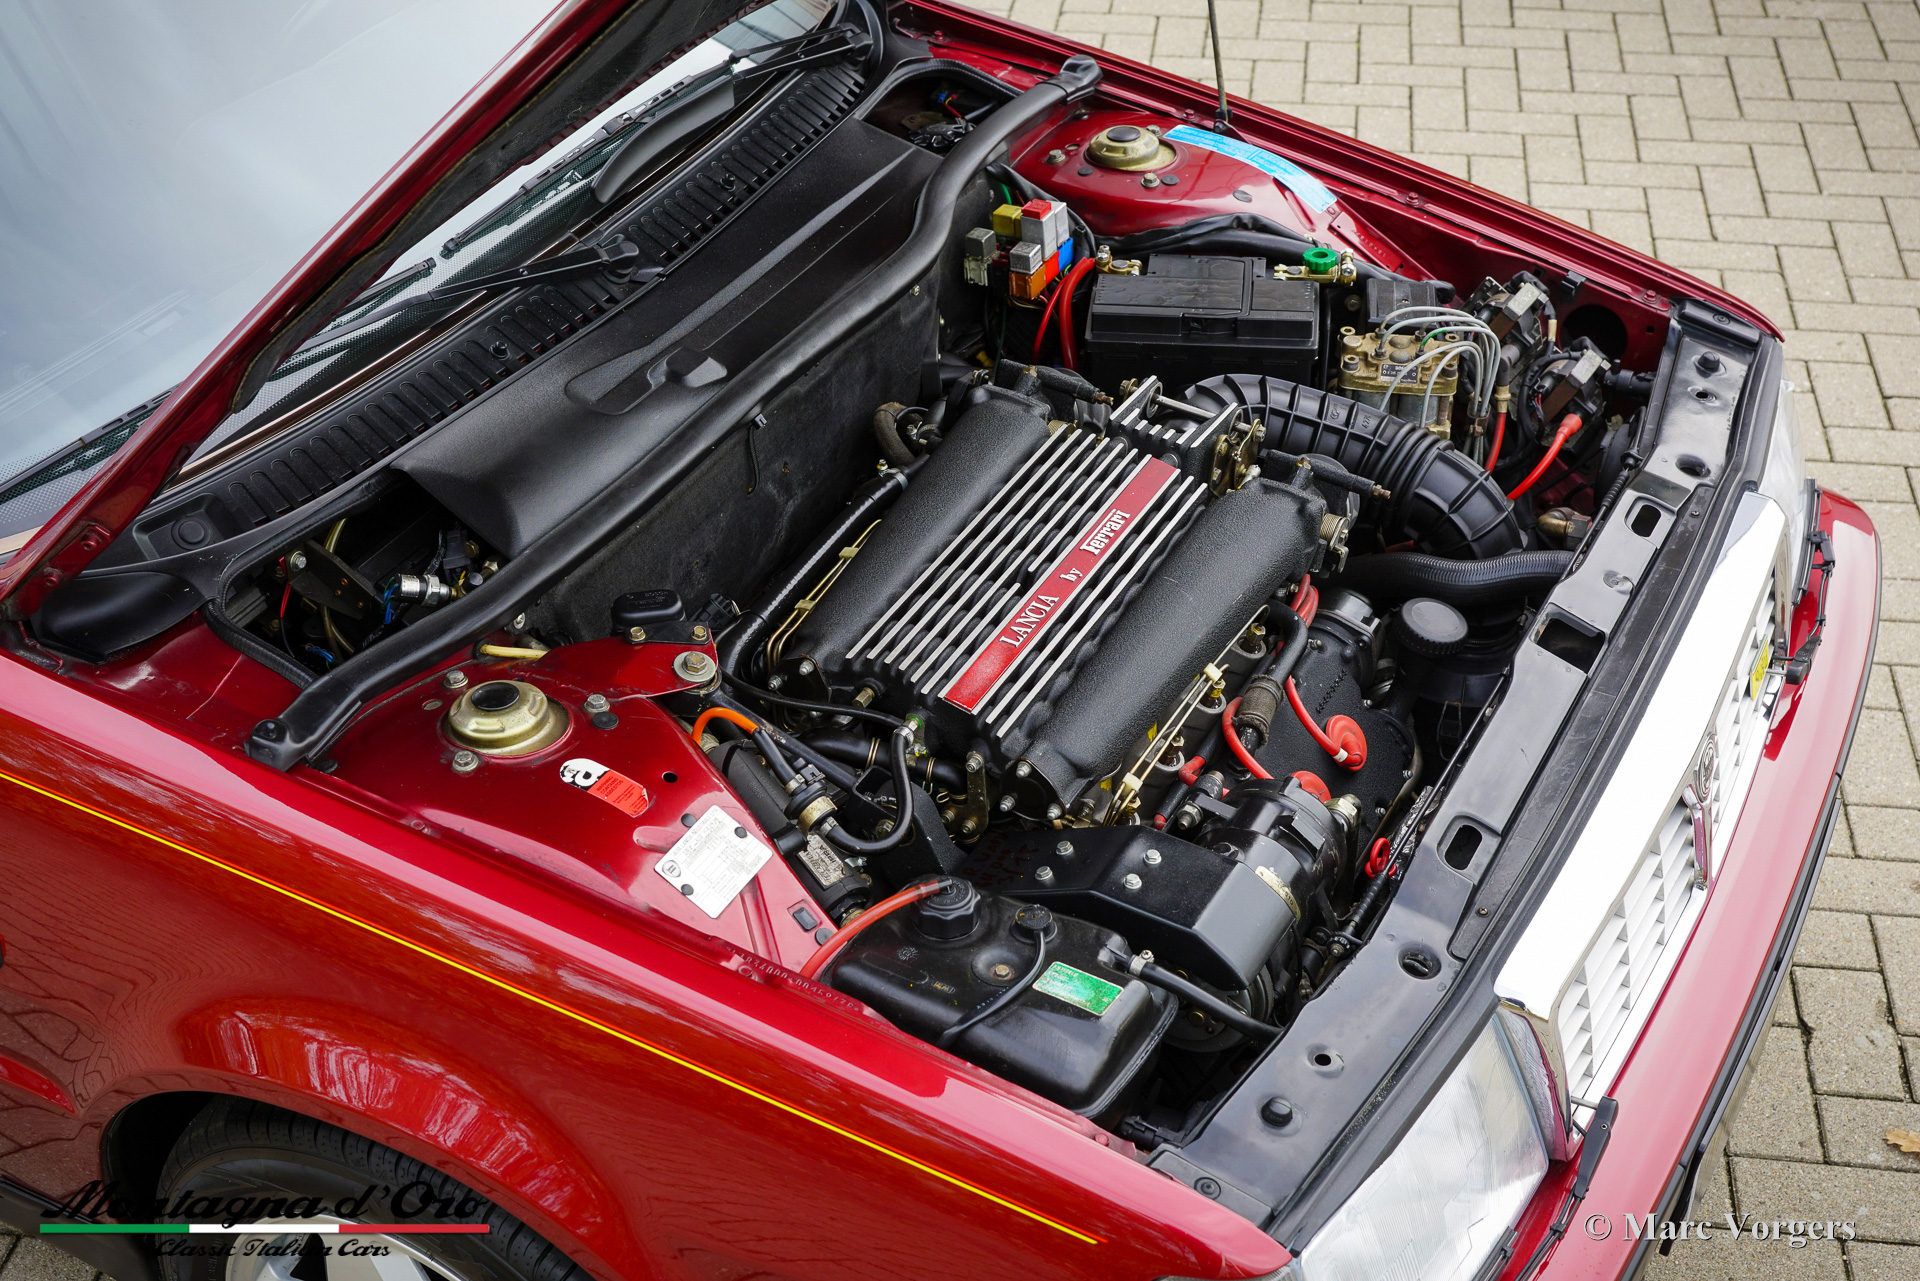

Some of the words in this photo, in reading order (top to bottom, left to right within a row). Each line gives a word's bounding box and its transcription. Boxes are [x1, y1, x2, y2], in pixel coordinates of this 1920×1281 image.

[999, 594, 1060, 648] LANCIA
[1059, 567, 1083, 583] by
[1079, 508, 1131, 555] Ferrari
